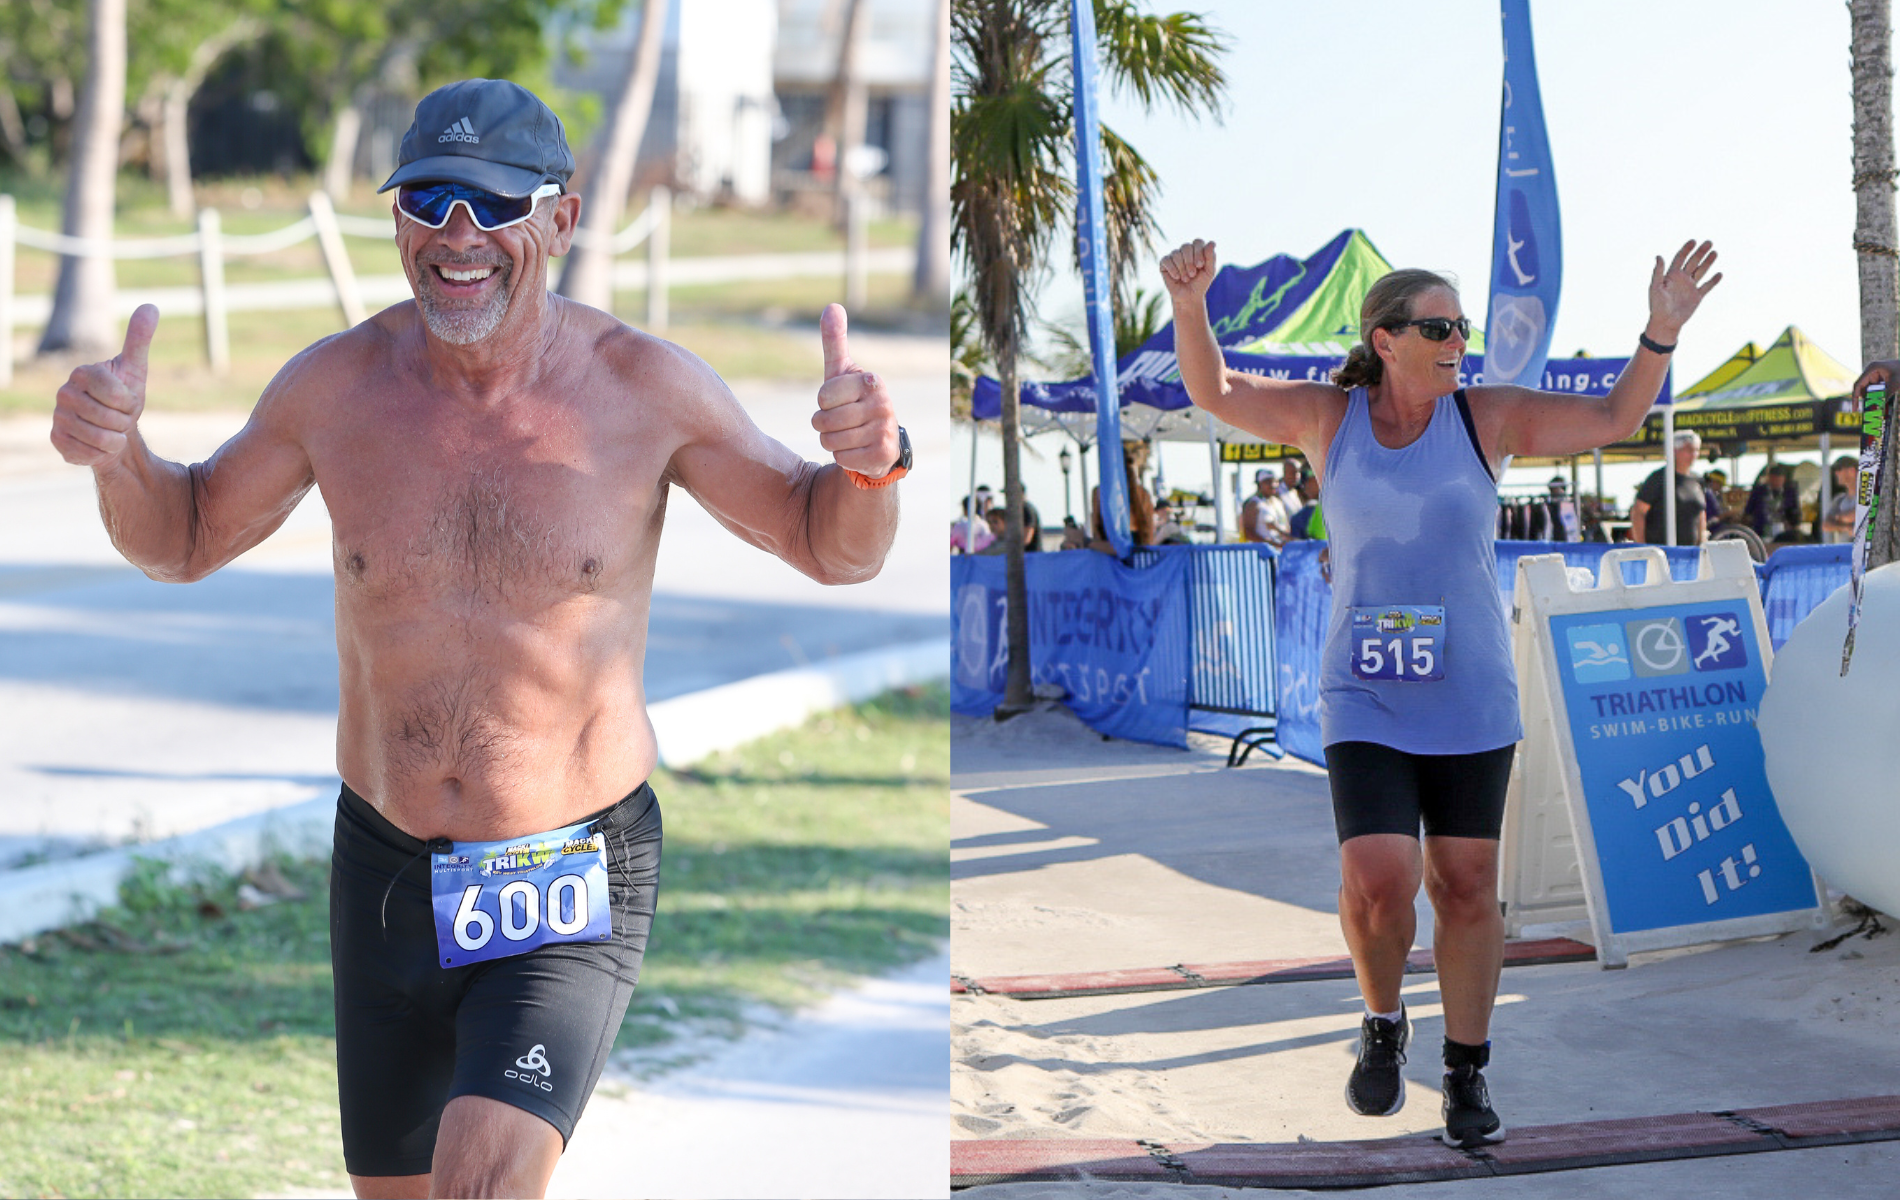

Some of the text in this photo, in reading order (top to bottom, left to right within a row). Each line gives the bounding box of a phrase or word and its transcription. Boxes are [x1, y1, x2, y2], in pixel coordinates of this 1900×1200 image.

[438, 132, 480, 144] adidas
[1359, 637, 1435, 676] 515
[1590, 681, 1747, 719] TRIATHLON
[1617, 744, 1716, 810] You
[1654, 787, 1744, 862] Did
[483, 850, 552, 872] TRIKW
[1697, 843, 1762, 906] It!
[452, 873, 589, 951] 600
[504, 1069, 553, 1092] odlo
